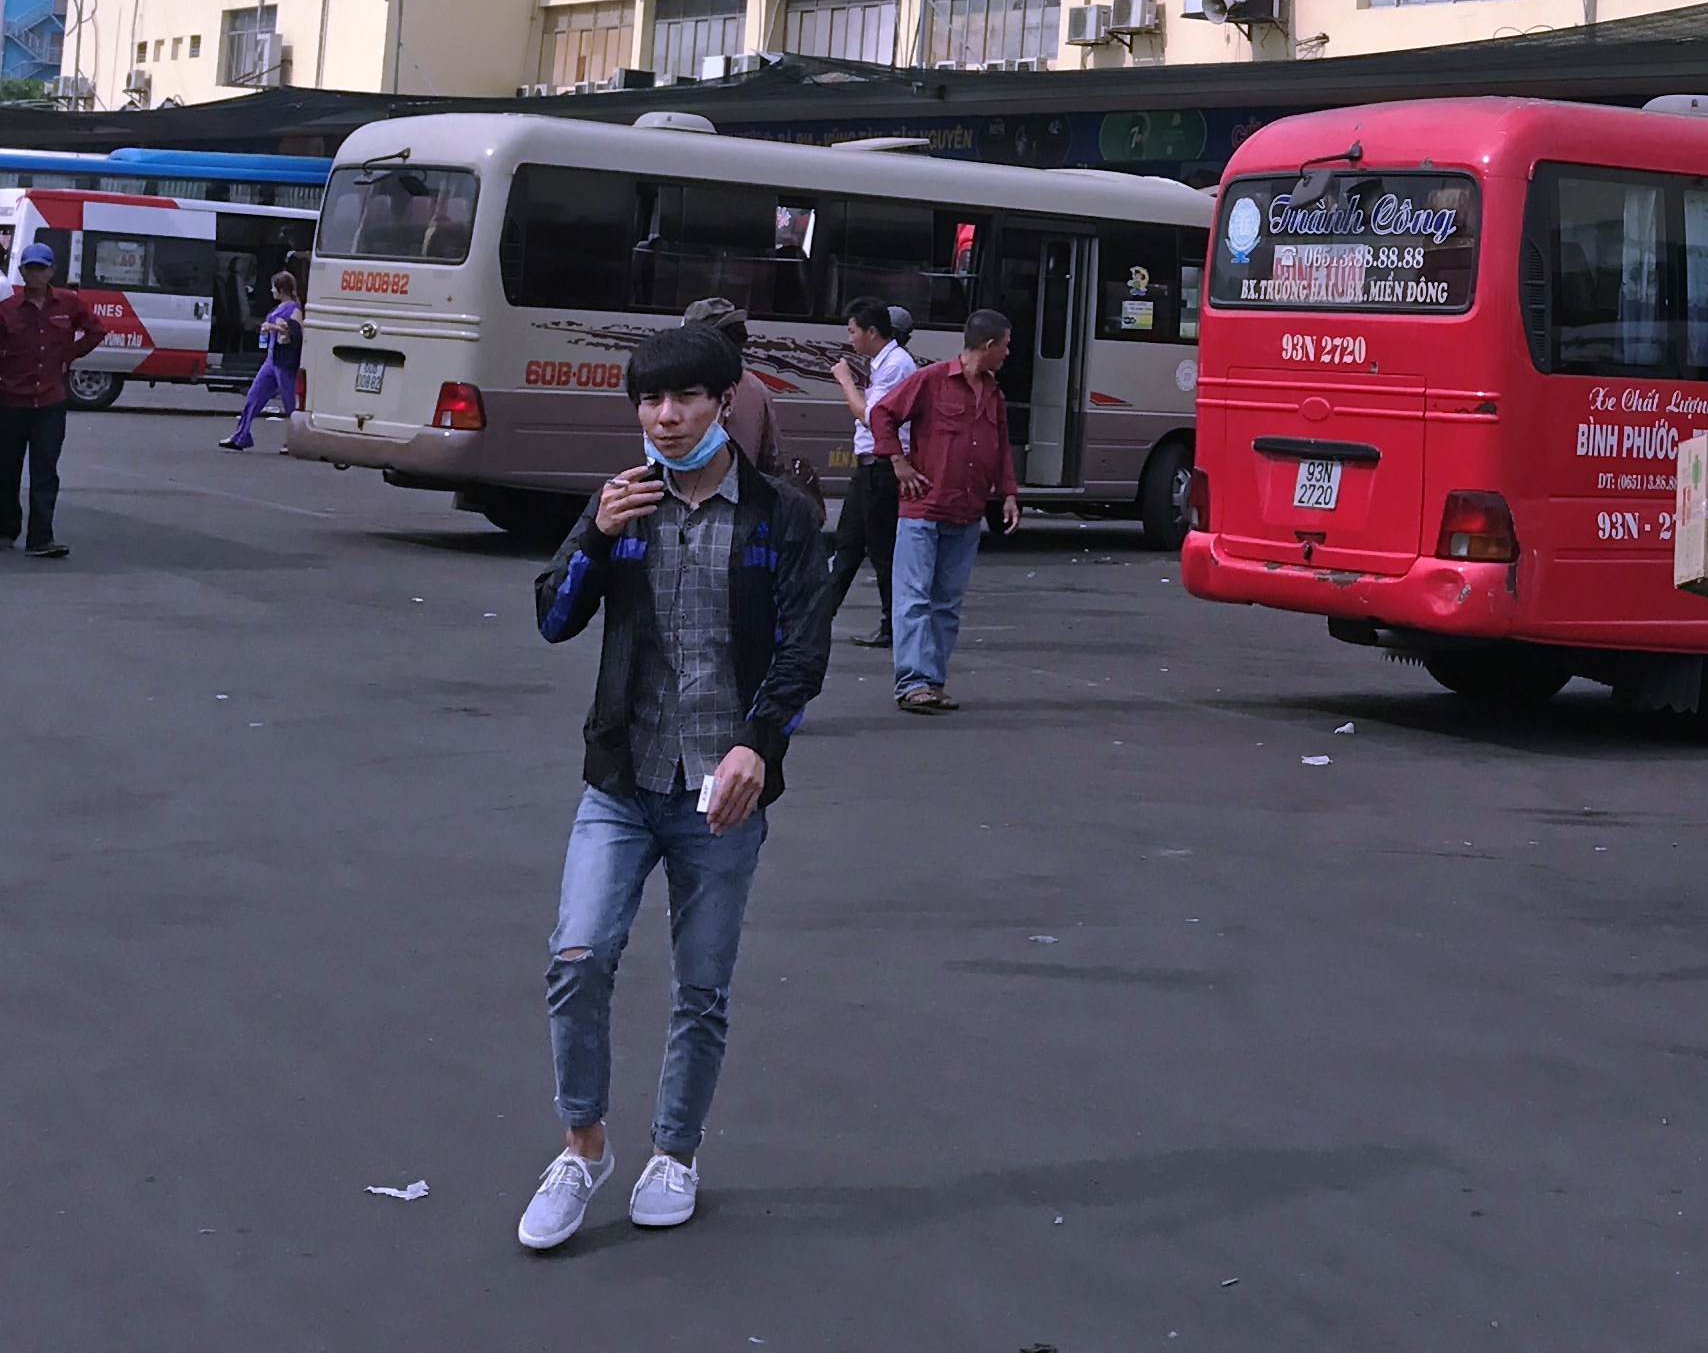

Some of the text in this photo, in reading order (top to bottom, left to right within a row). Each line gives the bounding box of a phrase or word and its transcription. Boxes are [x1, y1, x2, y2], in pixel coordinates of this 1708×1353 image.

[1371, 193, 1457, 245] Công
[1406, 275, 1448, 304] ĐÔNG
[1281, 333, 1366, 364] 93N 2720
[1589, 386, 1617, 411] Xe
[1621, 388, 1660, 412] Chất
[1577, 415, 1619, 458] BÌNH
[1621, 418, 1679, 460] PHƯỚC
[1306, 461, 1334, 483] 93N
[1297, 483, 1333, 506] 2720
[1597, 511, 1640, 540] 93N
